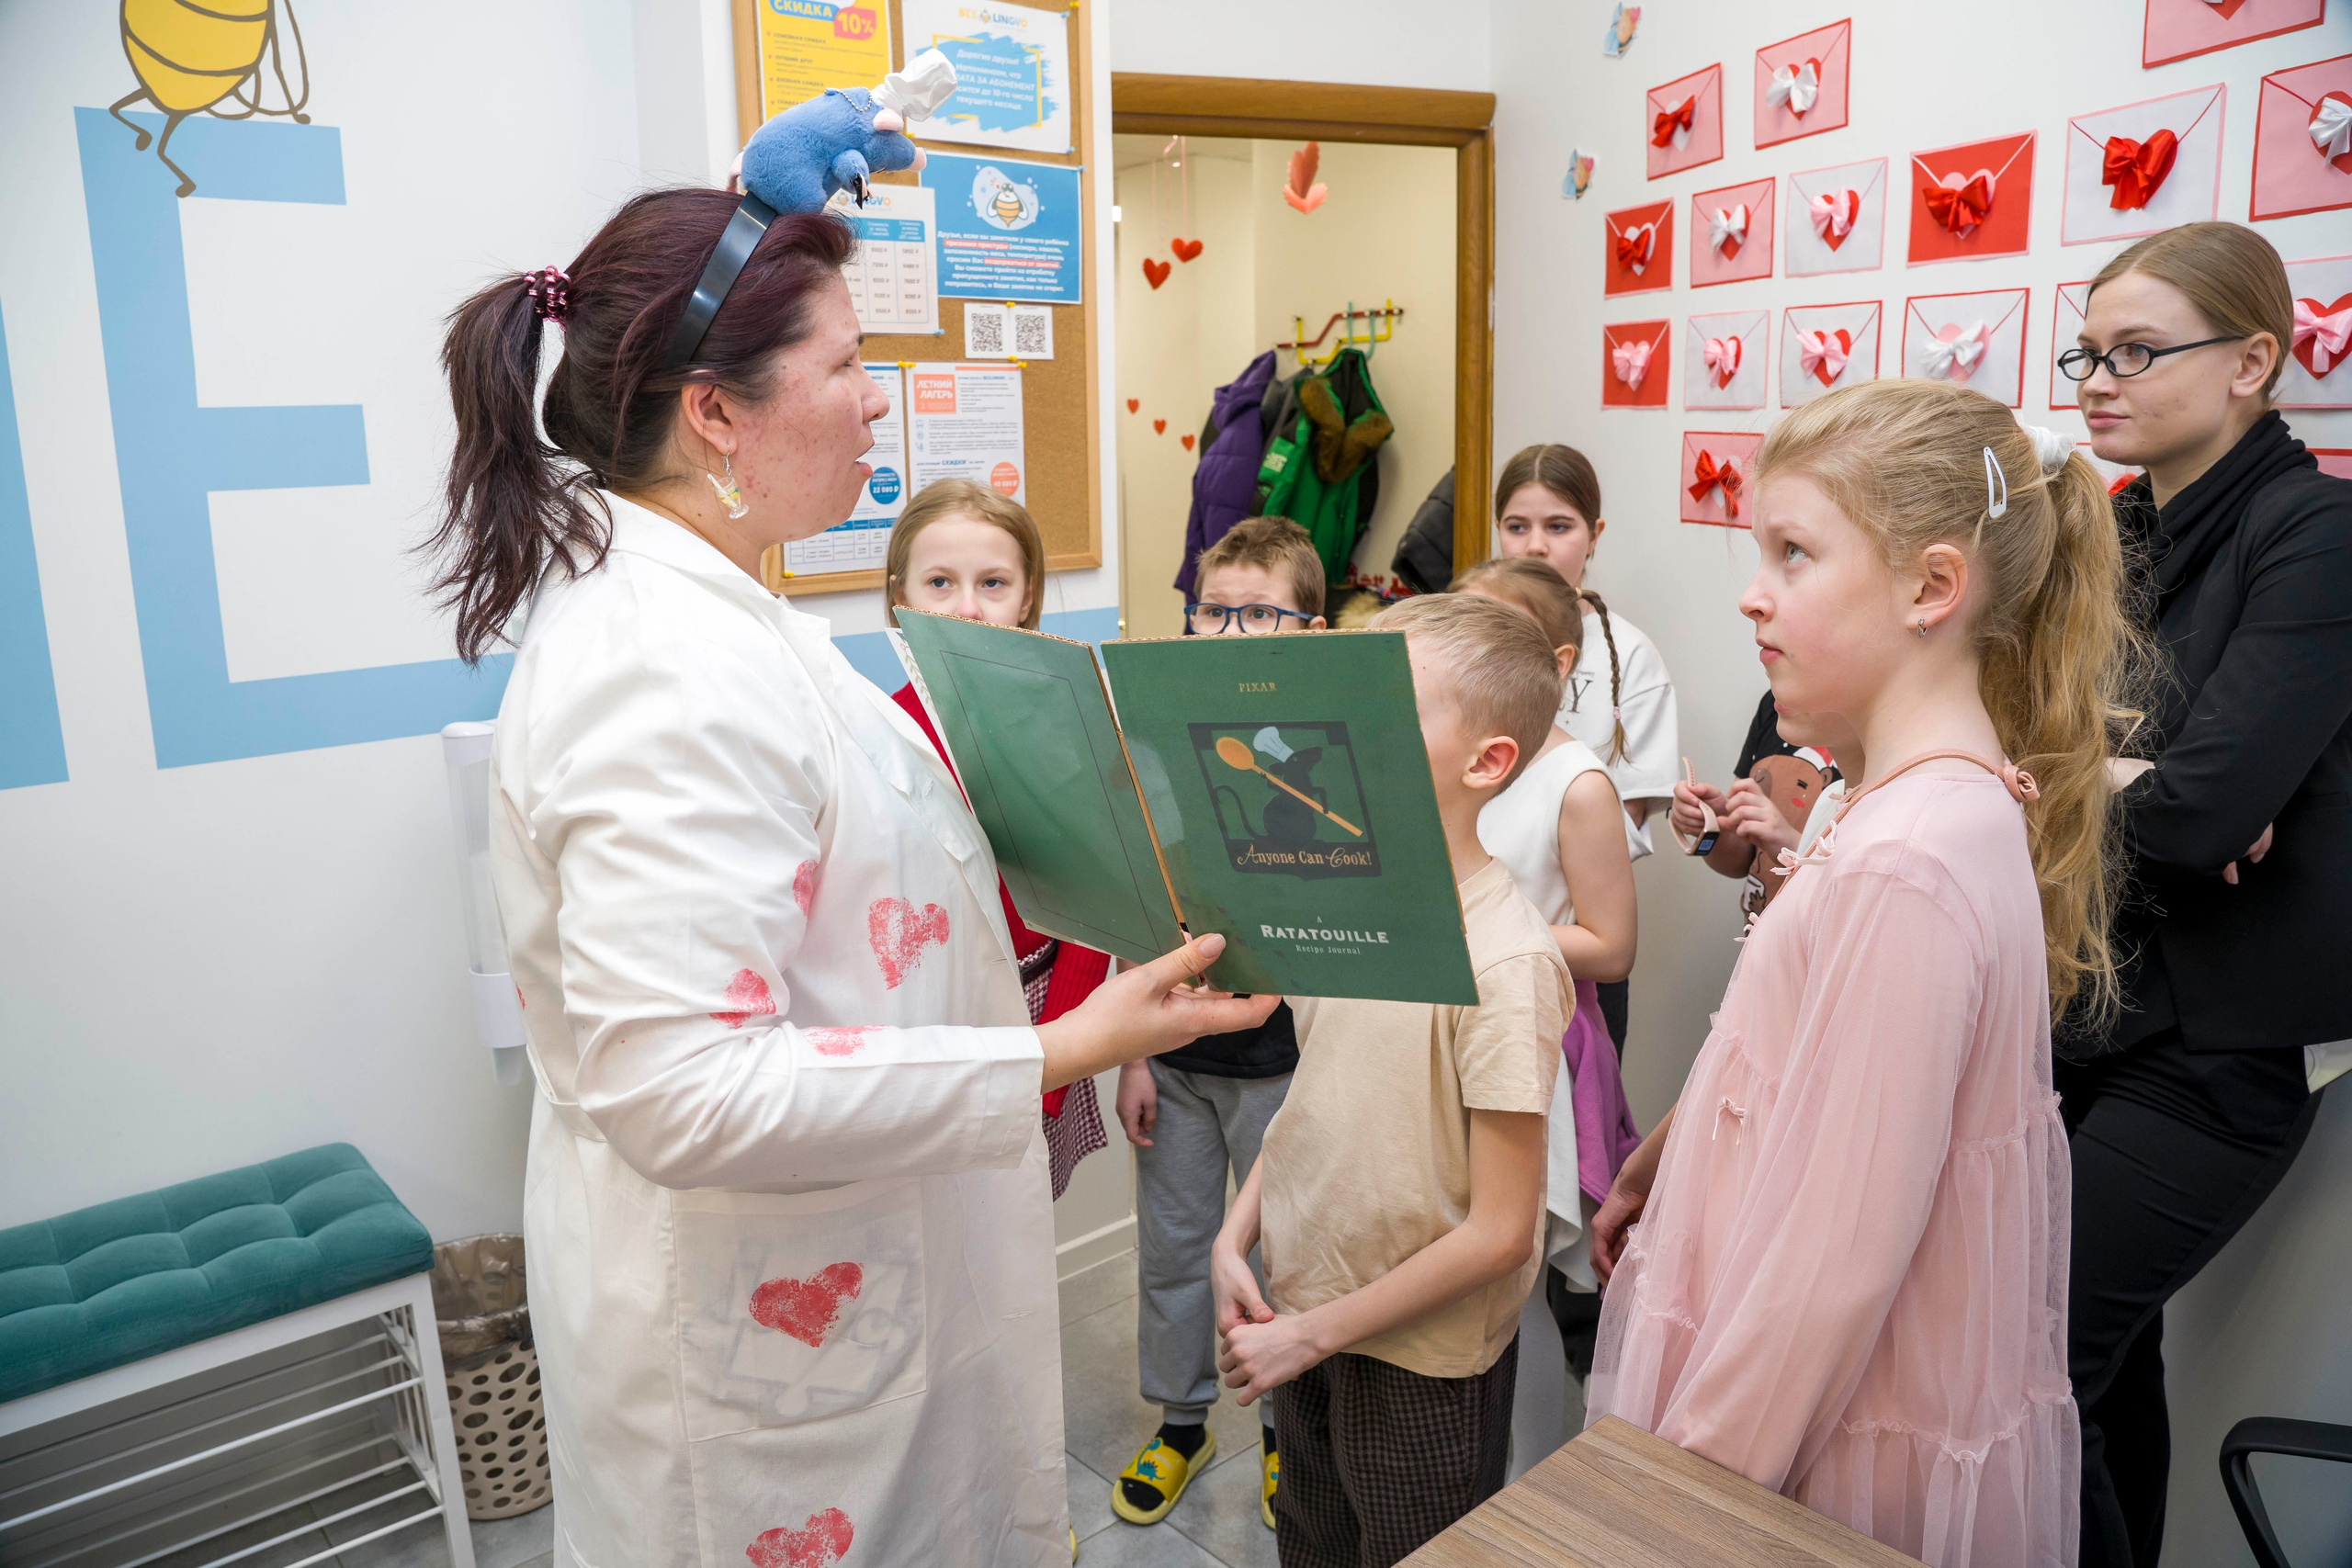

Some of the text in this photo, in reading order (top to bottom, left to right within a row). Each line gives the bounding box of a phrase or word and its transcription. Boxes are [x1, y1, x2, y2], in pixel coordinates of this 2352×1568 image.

[774, 0, 832, 17] СКИДКА
[837, 12, 874, 34] 10%
[992, 13, 1028, 28] LINGVO
[956, 50, 990, 62] Дорогие
[977, 75, 987, 85] ЗА
[989, 77, 1035, 92] АБОНЕМЕНТ
[956, 96, 993, 107] текущего
[937, 230, 963, 239] Друзья,
[917, 378, 953, 389] ЛЕТНИЙ
[919, 389, 954, 399] ЛАГЕРЬ
[1238, 682, 1277, 693] PIXAR
[1237, 843, 1373, 867] Anyone Can Cook!
[1260, 924, 1389, 944] RATATOUILLE
[1295, 944, 1361, 955] Recipe Journal
